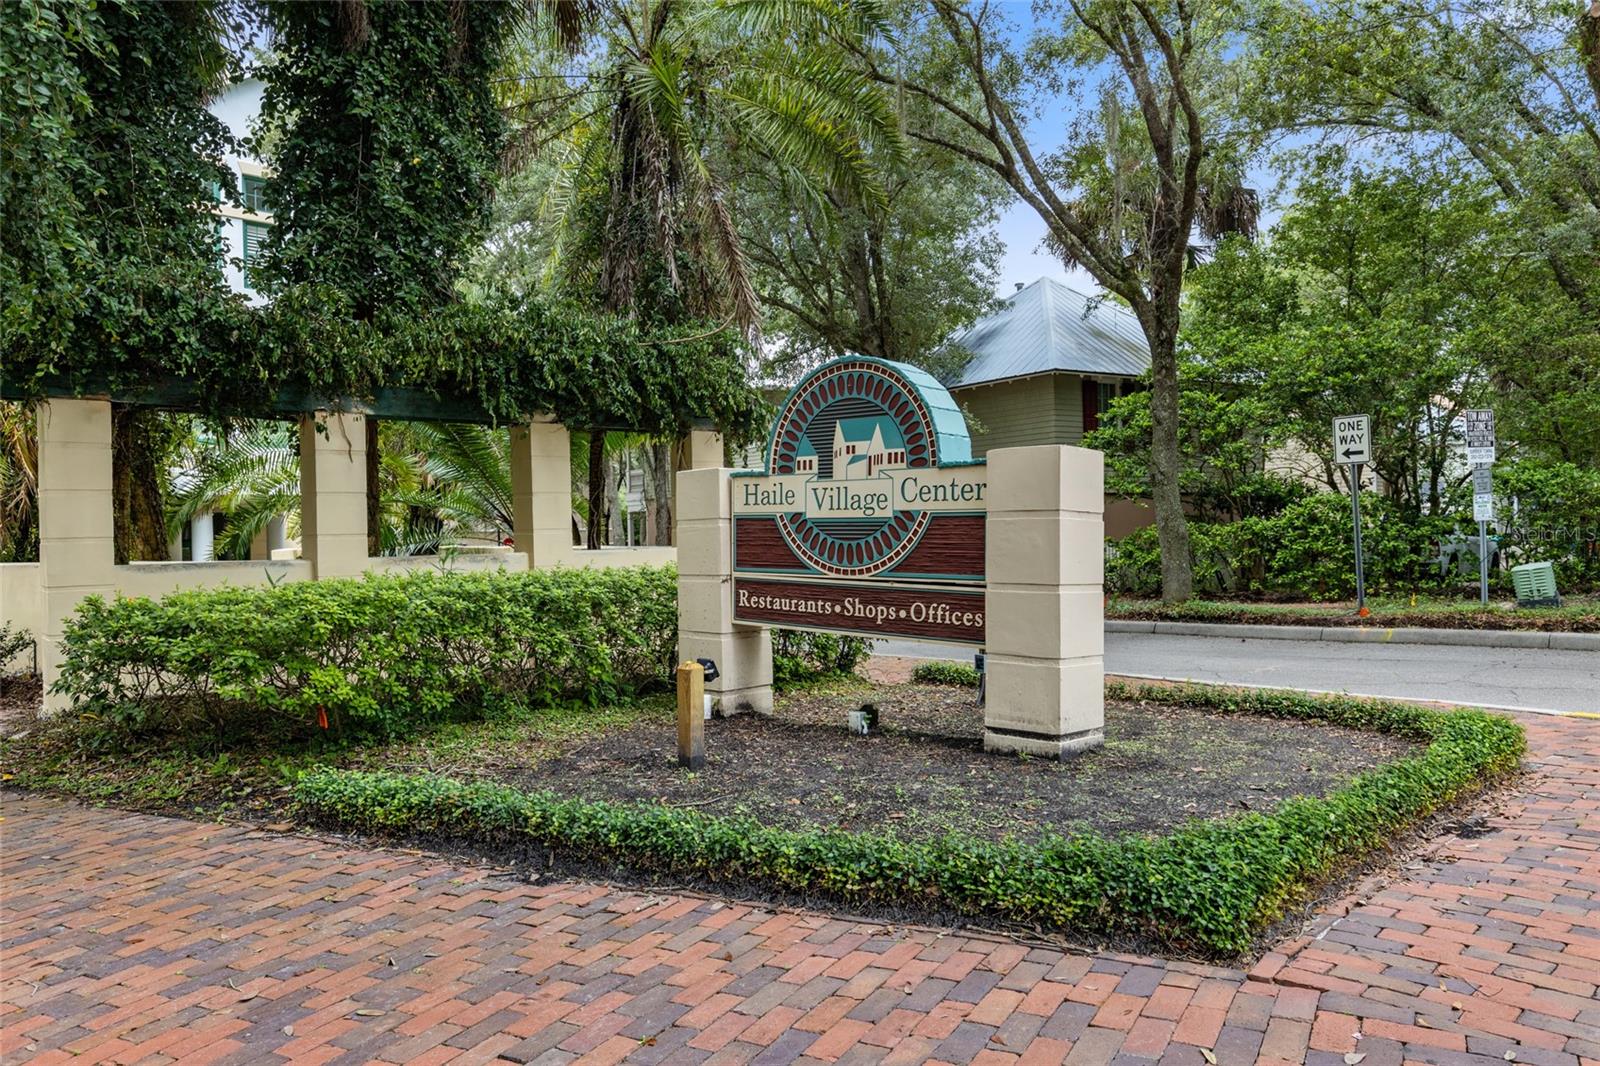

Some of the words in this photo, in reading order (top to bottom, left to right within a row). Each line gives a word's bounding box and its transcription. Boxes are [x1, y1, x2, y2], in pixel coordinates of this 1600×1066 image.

[1338, 420, 1364, 432] ONE
[1339, 433, 1365, 446] WAY
[743, 483, 796, 506] Haile
[811, 487, 889, 516] Village
[901, 477, 987, 503] Center
[738, 589, 832, 614] Restaurants
[844, 597, 897, 624] Shops
[910, 602, 984, 628] Offices
